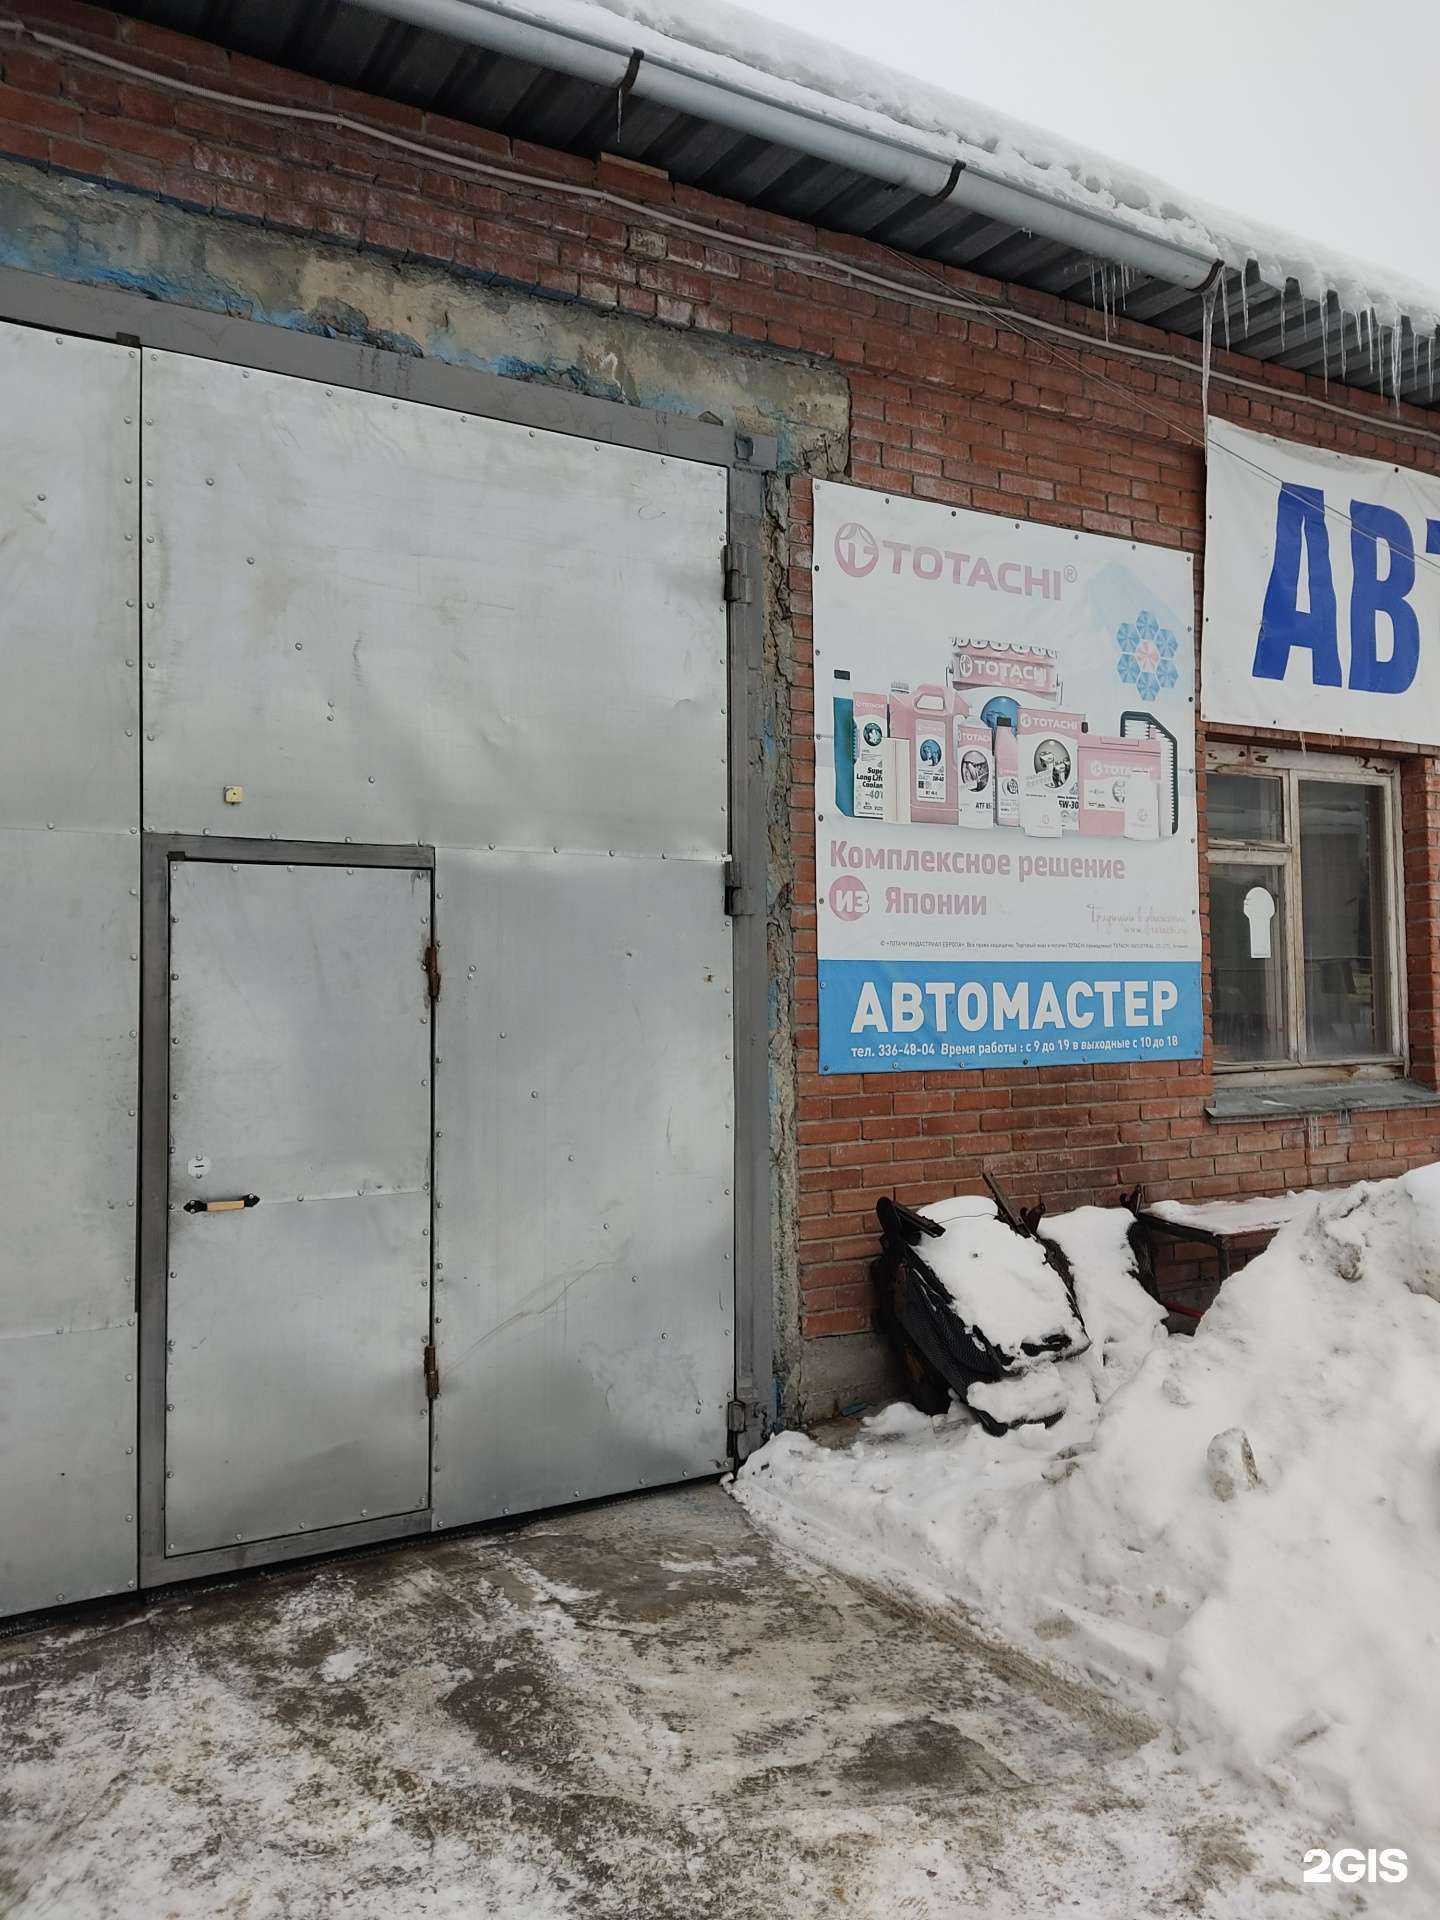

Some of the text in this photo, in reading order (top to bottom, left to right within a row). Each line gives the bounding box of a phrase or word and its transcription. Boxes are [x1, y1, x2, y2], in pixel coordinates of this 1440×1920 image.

[1252, 481, 1440, 695] АВ
[974, 660, 1047, 682] TOTACHI
[1032, 717, 1080, 730] TOTACHI
[829, 840, 1125, 882] Комплексное решение
[884, 887, 987, 915] Японии
[850, 980, 1178, 1033] АВТОМАСТЕР
[851, 1046, 875, 1057] тел.
[878, 1043, 935, 1057] 336-48-04
[941, 1043, 976, 1057] Время
[978, 1041, 1017, 1056] работы
[1033, 1040, 1040, 1052] 9
[1041, 1042, 1055, 1054] до
[1057, 1039, 1070, 1051] 19
[1072, 1040, 1079, 1050] в
[1081, 1038, 1131, 1051] выходные
[1140, 1036, 1152, 1048] 10
[1152, 1037, 1164, 1049] до
[1166, 1035, 1178, 1047] 18
